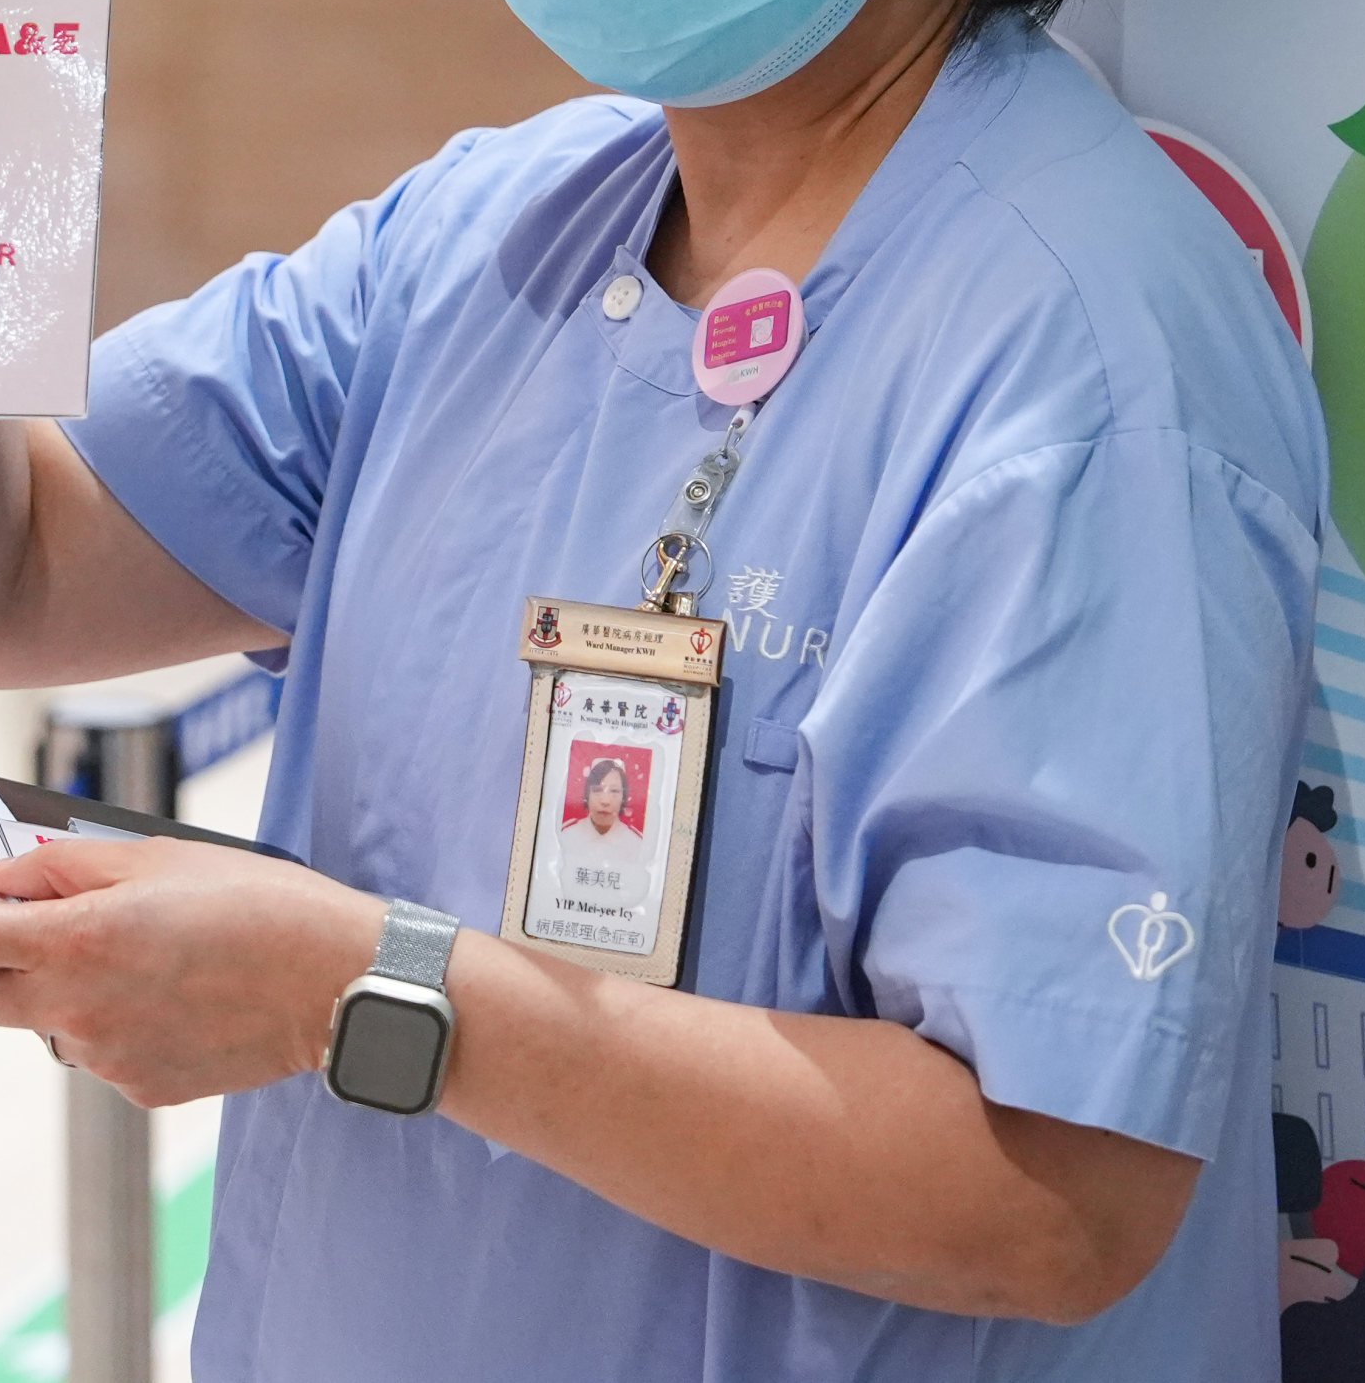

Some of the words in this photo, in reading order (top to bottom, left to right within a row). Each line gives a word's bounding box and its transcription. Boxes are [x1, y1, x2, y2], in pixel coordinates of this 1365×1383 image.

[740, 365, 759, 377] KWH
[727, 564, 786, 620] 護
[585, 640, 605, 652] Ward
[605, 643, 635, 656] Manager
[582, 697, 649, 720] 廣華醫院
[555, 898, 575, 910] YIP
